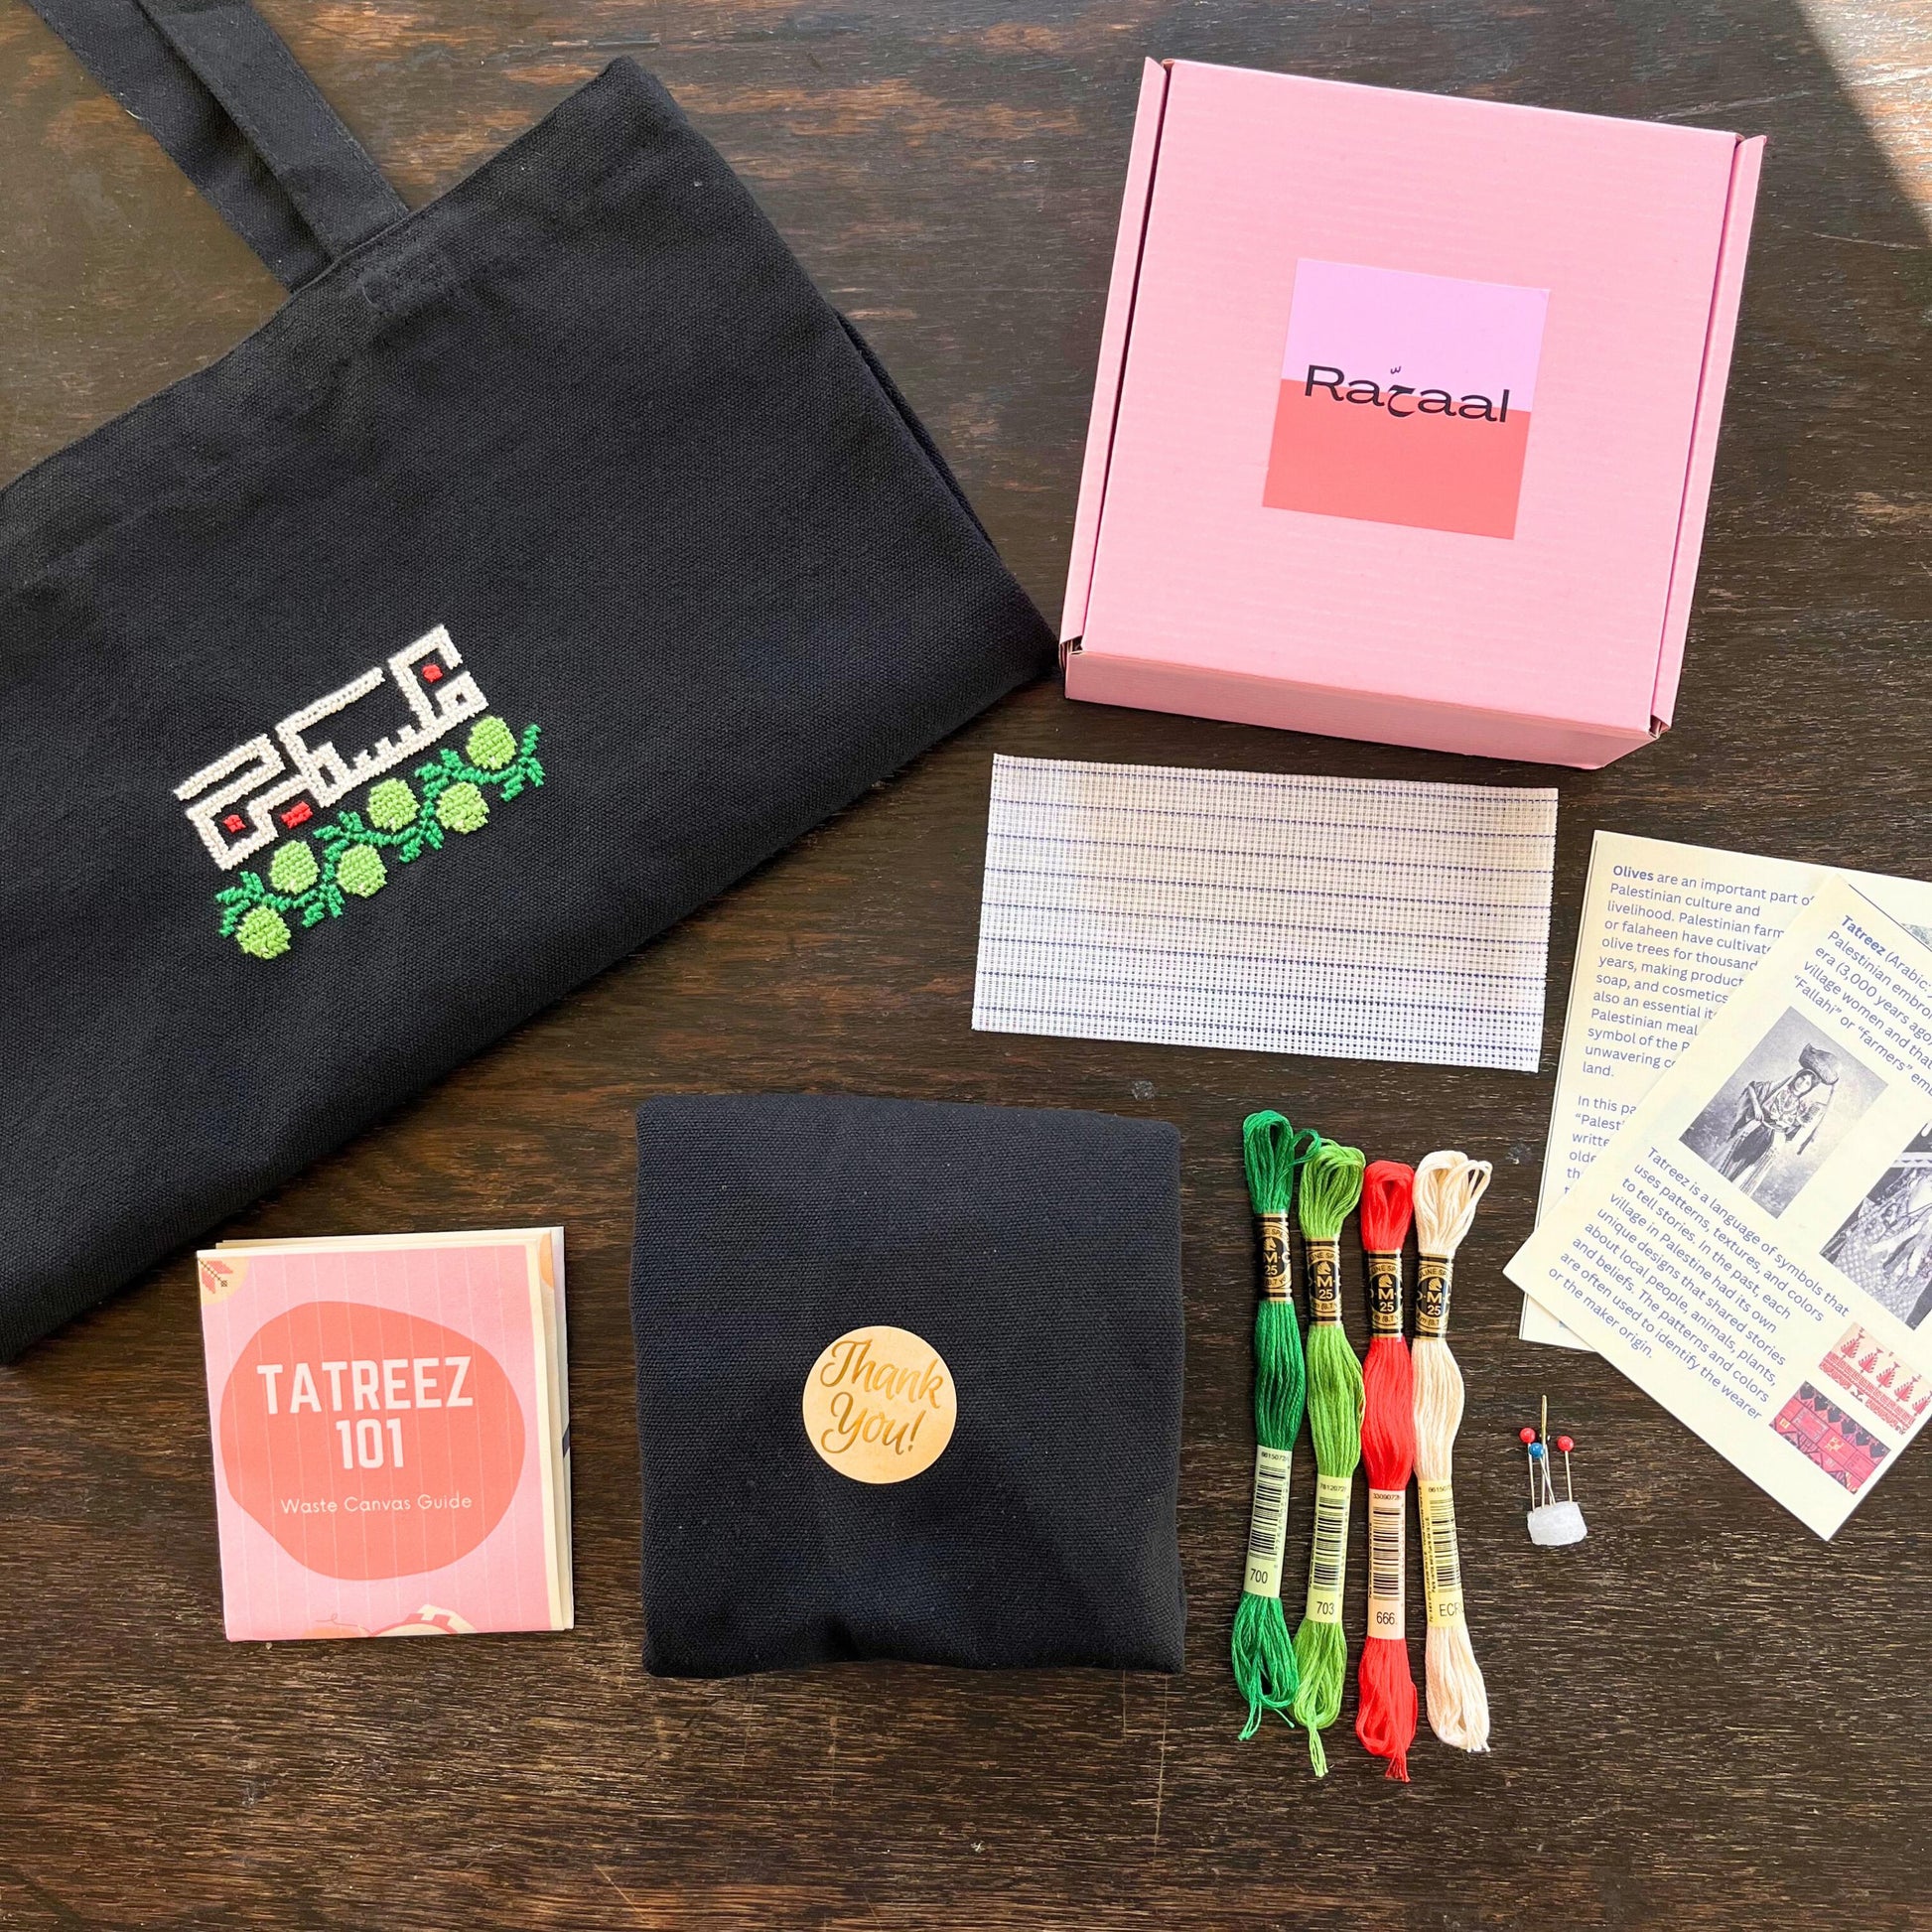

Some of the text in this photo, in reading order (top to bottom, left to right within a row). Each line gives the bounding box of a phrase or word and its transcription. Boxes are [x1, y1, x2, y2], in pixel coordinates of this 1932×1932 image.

[1609, 882, 1761, 917] Palestinian culture and
[1612, 865, 1816, 906] Olives are an important part o
[1607, 899, 1675, 922] livelihood.
[1679, 911, 1750, 934] Palestinian
[1601, 936, 1634, 952] olive
[1636, 942, 1670, 958] trees
[1673, 947, 1694, 961] for
[1604, 920, 1772, 955] or falaheen have cultivat
[1841, 914, 1886, 957] Tatreez
[1597, 956, 1637, 973] years,
[1640, 963, 1689, 982] making
[1827, 930, 1892, 986] Palestinian
[1595, 974, 1630, 991] soap,
[1633, 980, 1660, 993] and
[1815, 947, 1836, 967] era
[1835, 961, 1877, 998] (3,000
[1872, 995, 1910, 1025] years
[1590, 1008, 1663, 1030] Palestinian
[1592, 990, 1718, 1021] also an essential it
[1804, 961, 1842, 995] village
[1842, 992, 1884, 1030] women
[1884, 1027, 1911, 1049] and
[1587, 1028, 1636, 1044] symbol
[1638, 1035, 1655, 1046] of
[1655, 1037, 1678, 1051] the
[1840, 1016, 1856, 1030] or
[1583, 1061, 1614, 1077] land.
[1585, 1045, 1661, 1069] unwavering
[1578, 1095, 1589, 1107] In
[1593, 1097, 1617, 1112] this
[1621, 1177, 1791, 1319] to tell stories. In the past, each
[1634, 1164, 1824, 1321] uses patterns, textures, and colors
[1647, 1147, 1850, 1317] Tatreez is a language of symbols that
[1264, 1265, 1278, 1276] 25
[1610, 1193, 1777, 1333] village in Palestine had its own
[1318, 1289, 1333, 1300] 25
[1596, 1208, 1786, 1366] unique designs that shared stories
[1379, 1301, 1395, 1312] 25
[1427, 1305, 1442, 1316] 25
[1549, 1268, 1652, 1359] or the maker origin.
[1572, 1238, 1769, 1403] and beliefs. The patterns and colors
[1585, 1223, 1776, 1387] about local people, animals, plants,
[1560, 1253, 1762, 1420] are often used to identify the wearer
[256, 1355, 475, 1415] TATREEZ
[819, 1338, 944, 1410] Thank
[820, 1391, 927, 1456] You!
[336, 1417, 405, 1470] 101
[280, 1490, 474, 1515] Waste Canvas Guide
[1250, 1568, 1269, 1585] 700
[1315, 1600, 1335, 1615] 703
